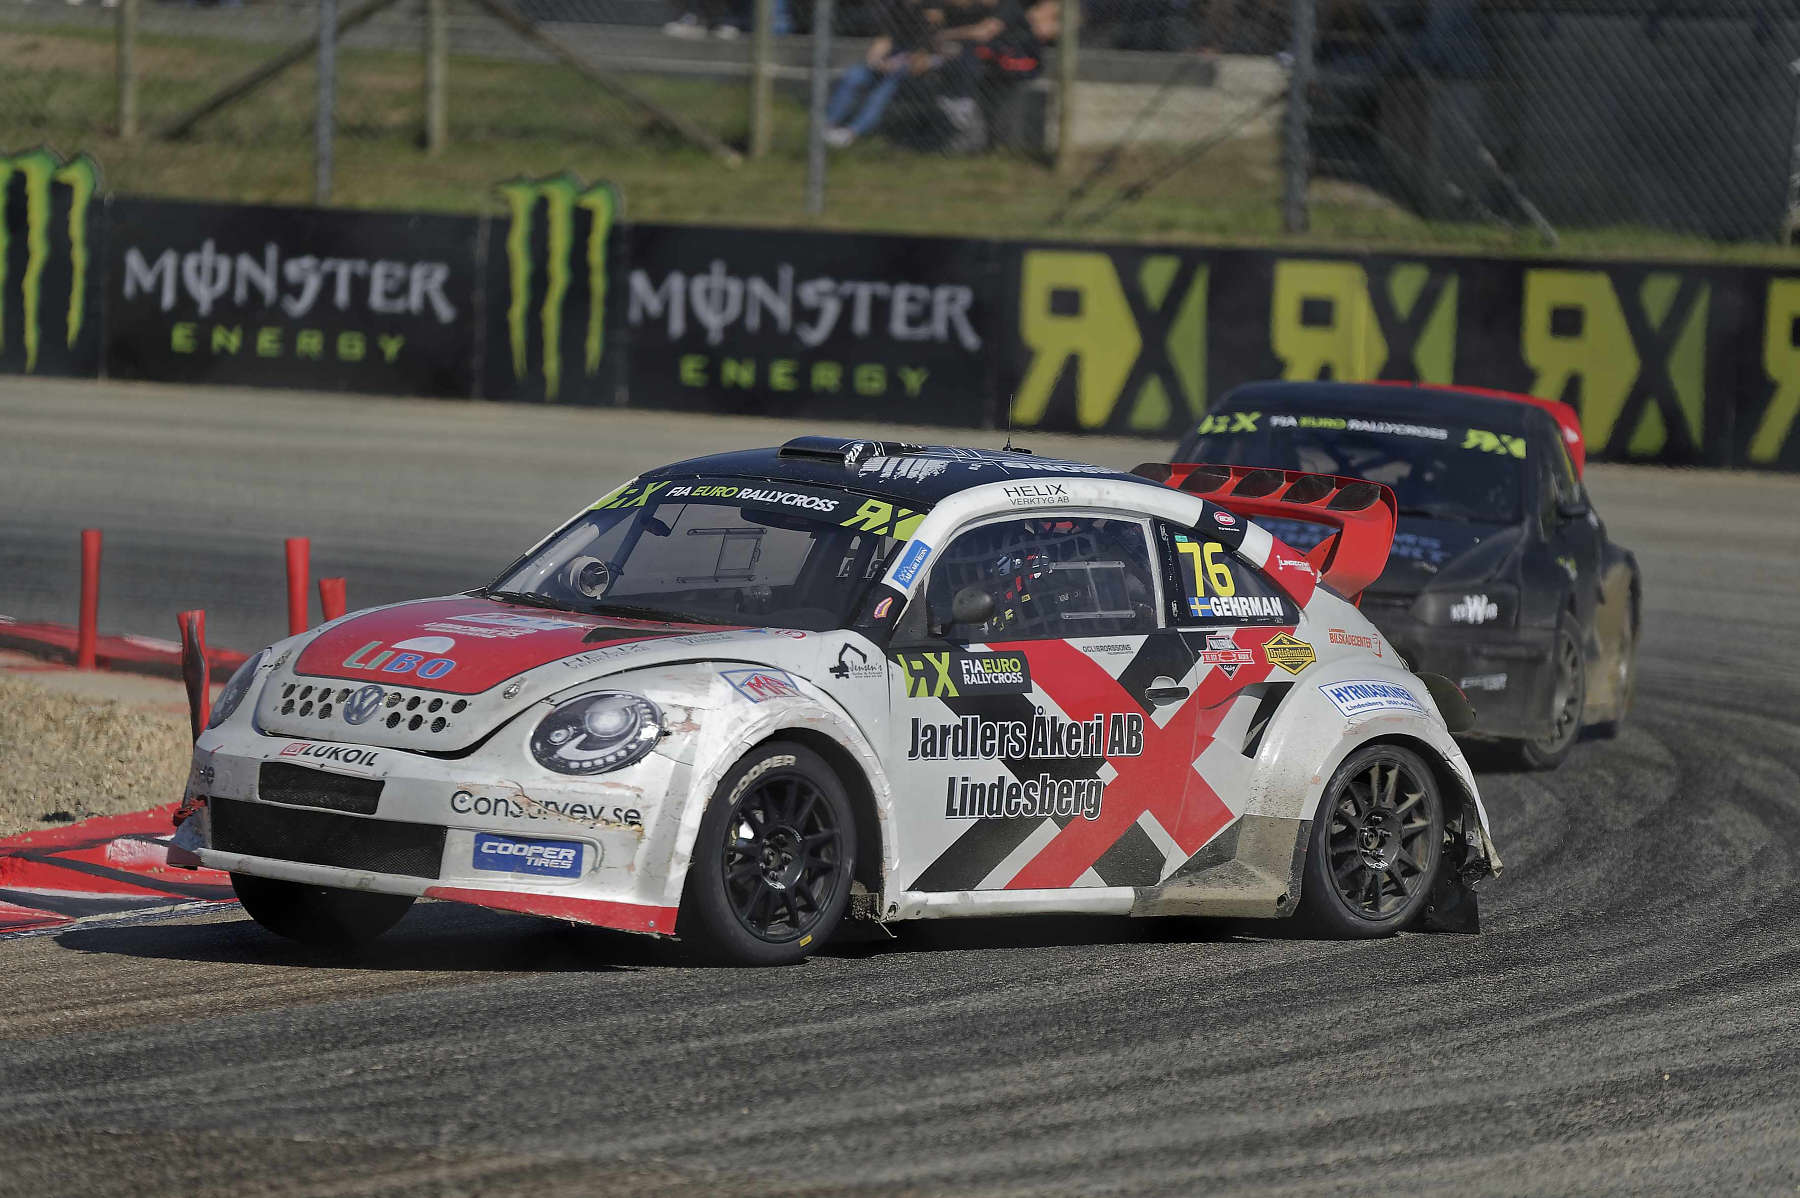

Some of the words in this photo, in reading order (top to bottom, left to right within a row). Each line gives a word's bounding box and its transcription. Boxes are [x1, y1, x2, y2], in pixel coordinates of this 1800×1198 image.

[122, 238, 457, 323] MONSTER
[628, 259, 982, 352] MONSTER
[171, 321, 405, 363] ENERGY
[678, 354, 930, 397] ENERGY
[665, 486, 691, 498] FIA
[690, 485, 739, 499] EURO
[735, 488, 840, 513] RALLYCROSS
[1003, 484, 1068, 498] HELIX
[1057, 496, 1070, 504] AB
[1176, 542, 1236, 598] 76
[1210, 597, 1285, 617] GEHRMAN
[960, 659, 985, 674] FIA
[983, 657, 1022, 673] EURO
[963, 672, 1024, 686] RALLYCROSS
[907, 714, 1028, 761] Jardlers
[1028, 704, 1104, 760] Åkeri
[1106, 713, 1145, 758] AB
[302, 744, 380, 767] LUKOIL
[945, 772, 1104, 821] Lindesberg
[480, 840, 577, 861] COOPER
[525, 856, 574, 869] TIRES
